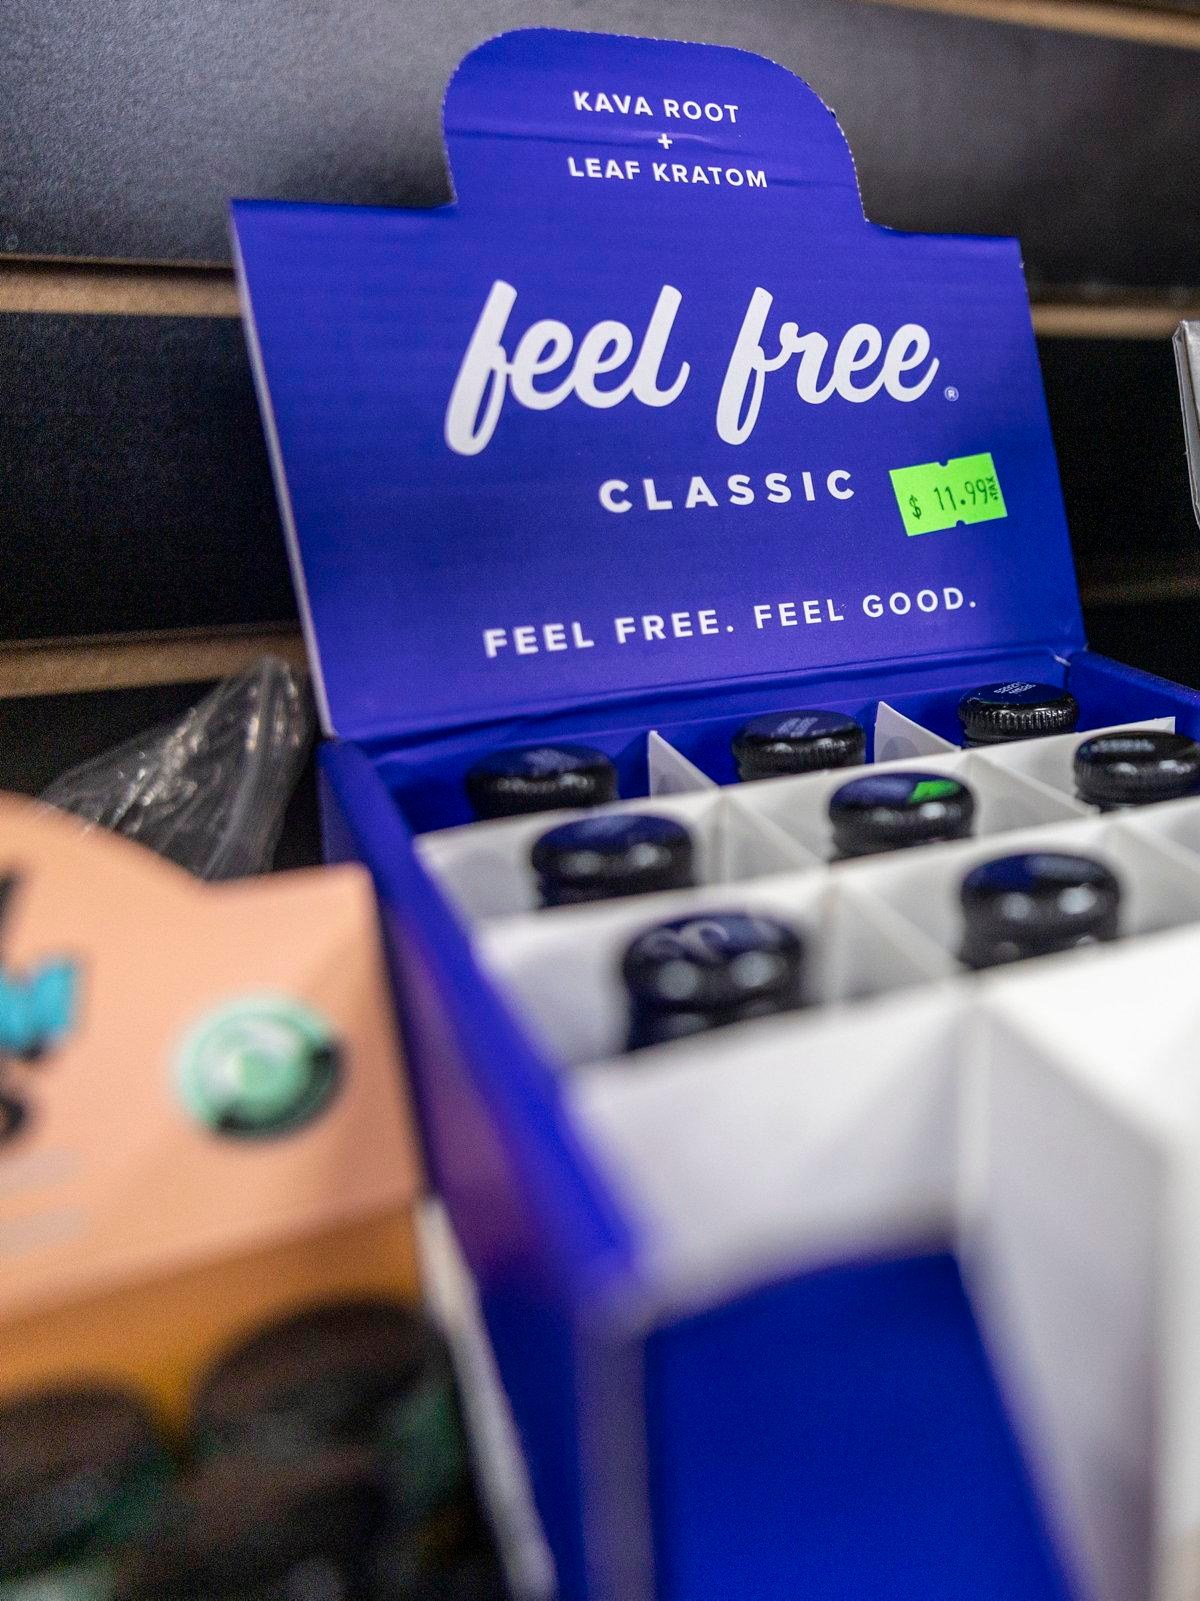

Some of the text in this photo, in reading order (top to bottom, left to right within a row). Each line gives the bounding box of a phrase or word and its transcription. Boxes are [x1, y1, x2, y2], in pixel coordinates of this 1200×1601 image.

[573, 91, 740, 124] KAVA ROOT
[567, 156, 769, 189] LEAF KRATOM
[444, 279, 691, 457] feel
[598, 469, 856, 515] CLASSIC
[909, 494, 922, 520] $
[934, 478, 989, 511] 11.99
[483, 587, 977, 659] FEEL FREE. FEEL GOOD.
